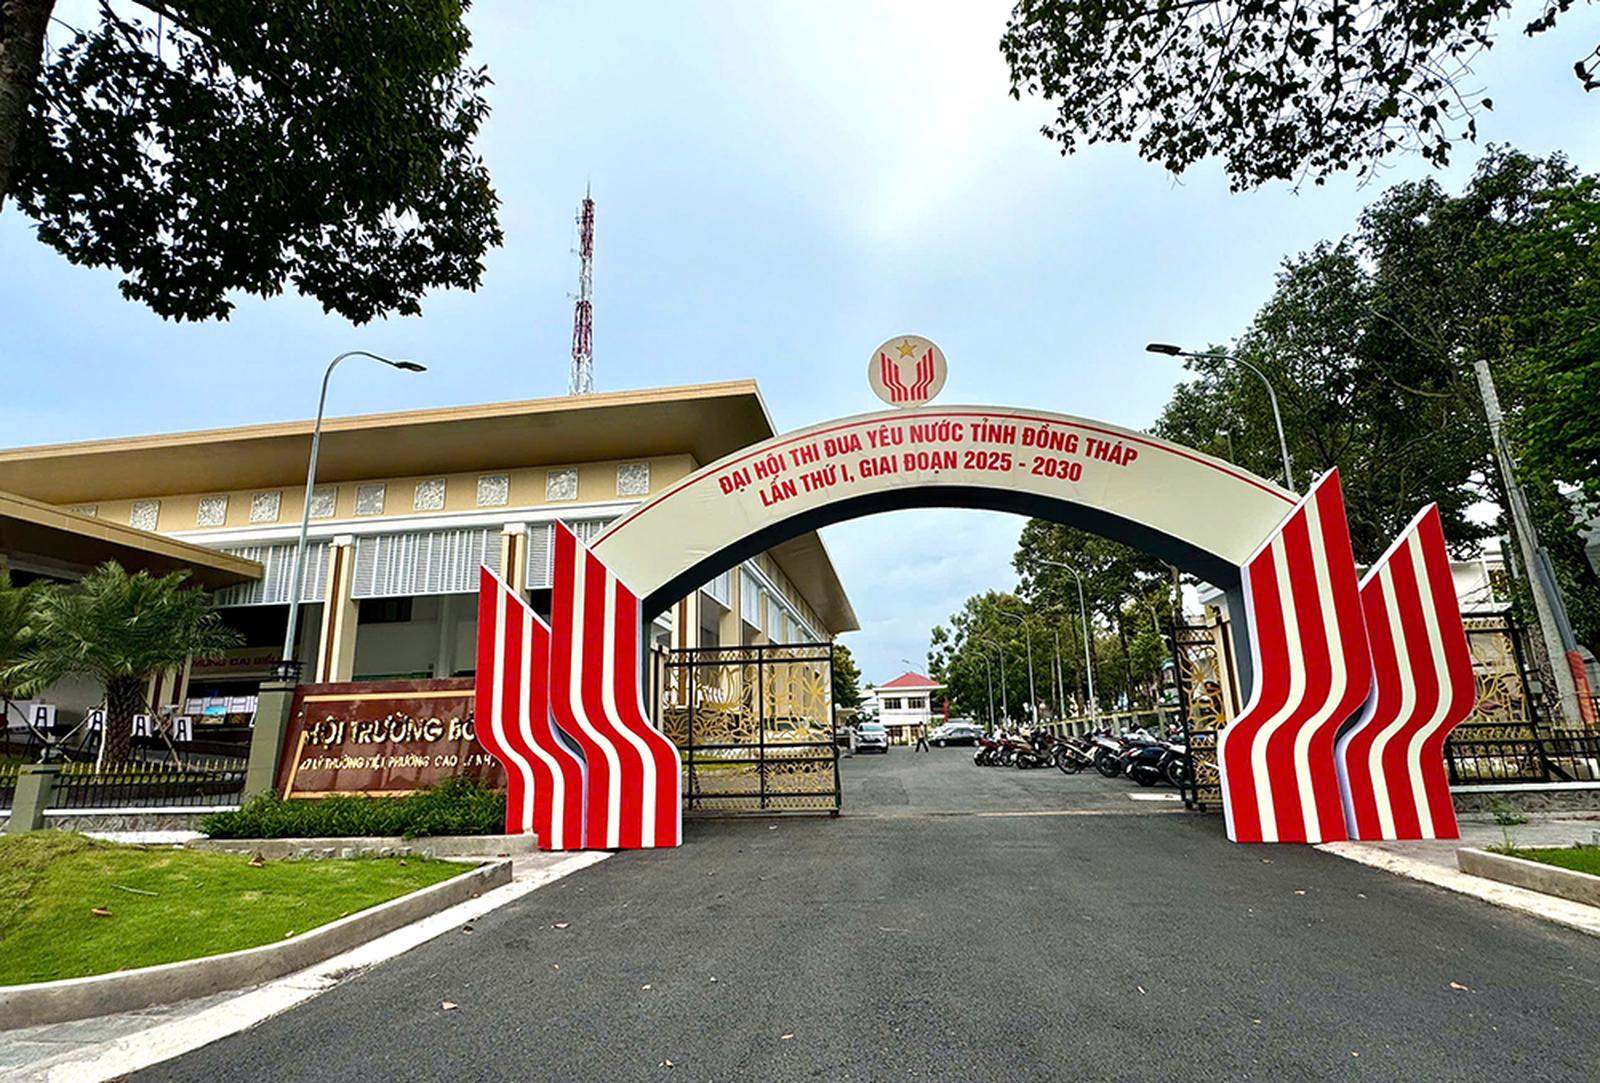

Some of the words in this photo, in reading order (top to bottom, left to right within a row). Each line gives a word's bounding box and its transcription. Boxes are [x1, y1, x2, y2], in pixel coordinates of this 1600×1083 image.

[718, 467, 752, 495] ĐẠI
[754, 453, 787, 478] HỘI
[789, 443, 820, 467] THI
[824, 434, 863, 457] ĐUA
[866, 425, 903, 448] YÊU
[910, 419, 963, 443] NƯỚC
[970, 418, 1016, 445] TỈNH
[1022, 424, 1079, 454] ĐỒNG
[1084, 437, 1138, 466] THÁP
[799, 464, 836, 492] THỨ
[841, 464, 855, 484] I,
[859, 455, 898, 479] GIAI
[904, 451, 957, 474] ĐOẠN
[963, 451, 1012, 472] 2025
[1031, 456, 1083, 482] 2030
[434, 754, 458, 767] CAO
